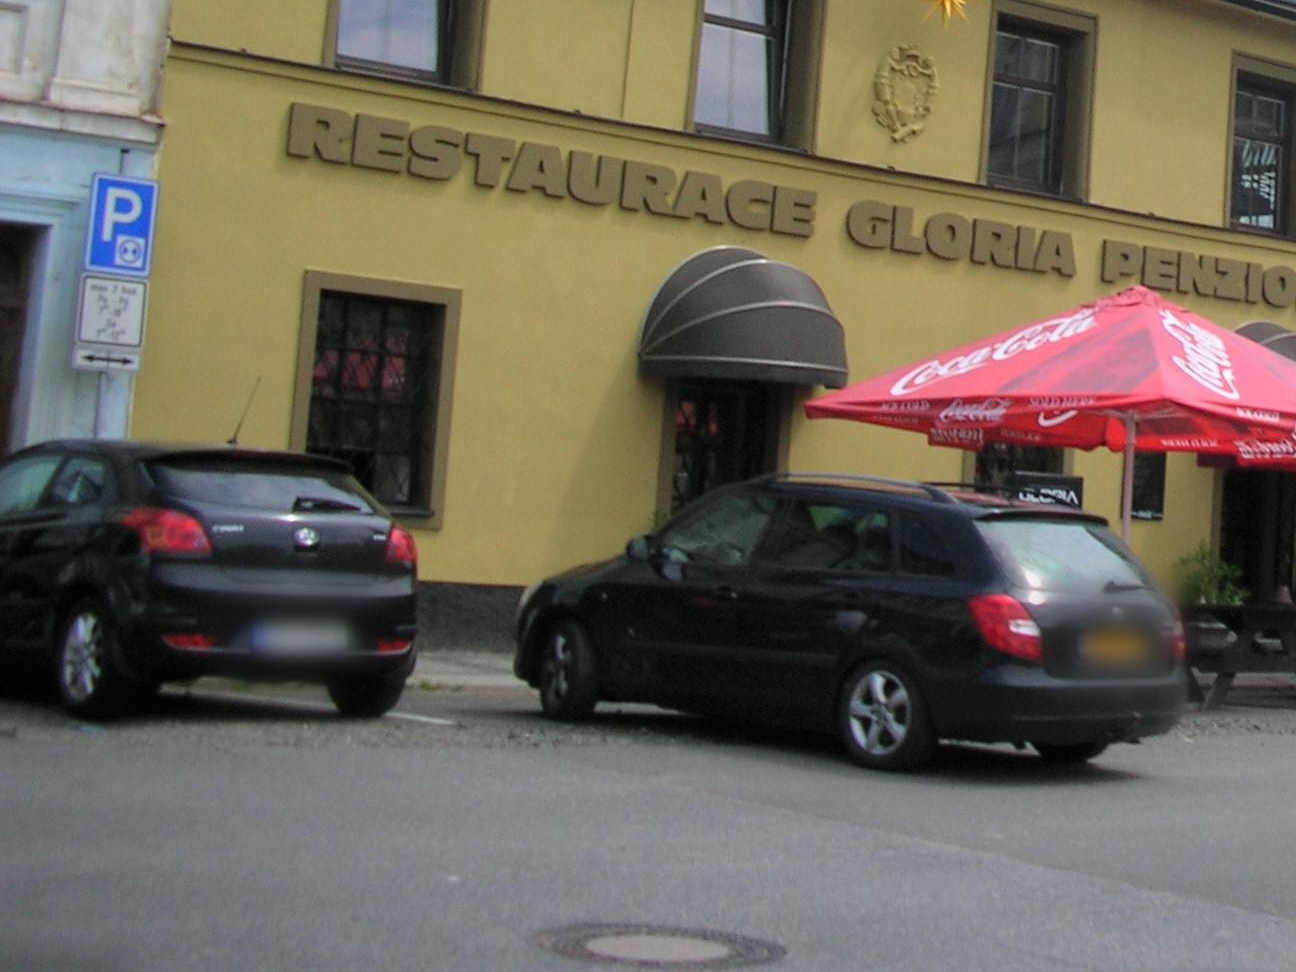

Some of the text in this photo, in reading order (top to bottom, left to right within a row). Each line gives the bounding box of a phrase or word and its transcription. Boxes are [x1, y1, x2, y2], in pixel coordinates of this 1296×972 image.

[101, 186, 143, 243] P
[286, 102, 818, 238] RESTAURACE
[846, 201, 1078, 280] GLORIA
[890, 307, 1097, 397] Coca-Cola
